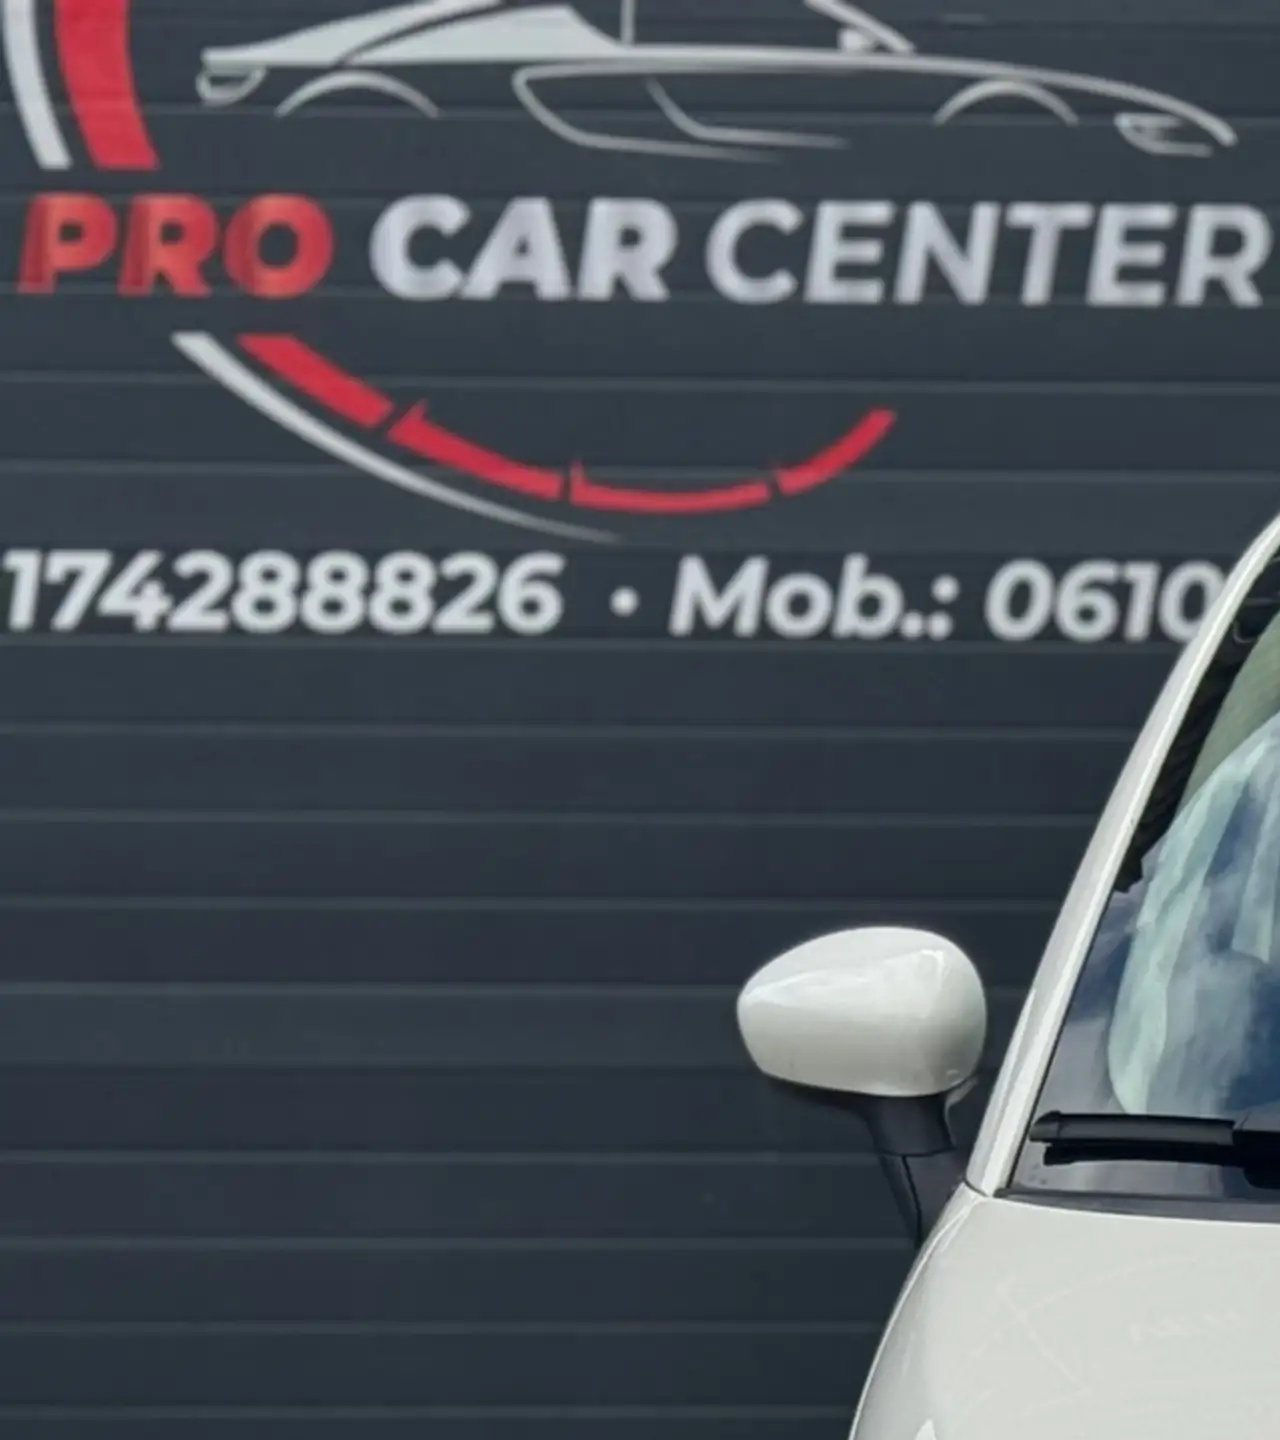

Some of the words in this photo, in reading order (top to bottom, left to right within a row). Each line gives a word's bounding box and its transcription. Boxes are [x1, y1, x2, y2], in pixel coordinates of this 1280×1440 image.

[17, 191, 334, 299] PRO
[369, 194, 679, 302] CAR
[705, 198, 1272, 308] CENTER
[2, 549, 566, 635] 174288826
[668, 553, 959, 639] Mob.:
[984, 559, 1227, 643] 0610
